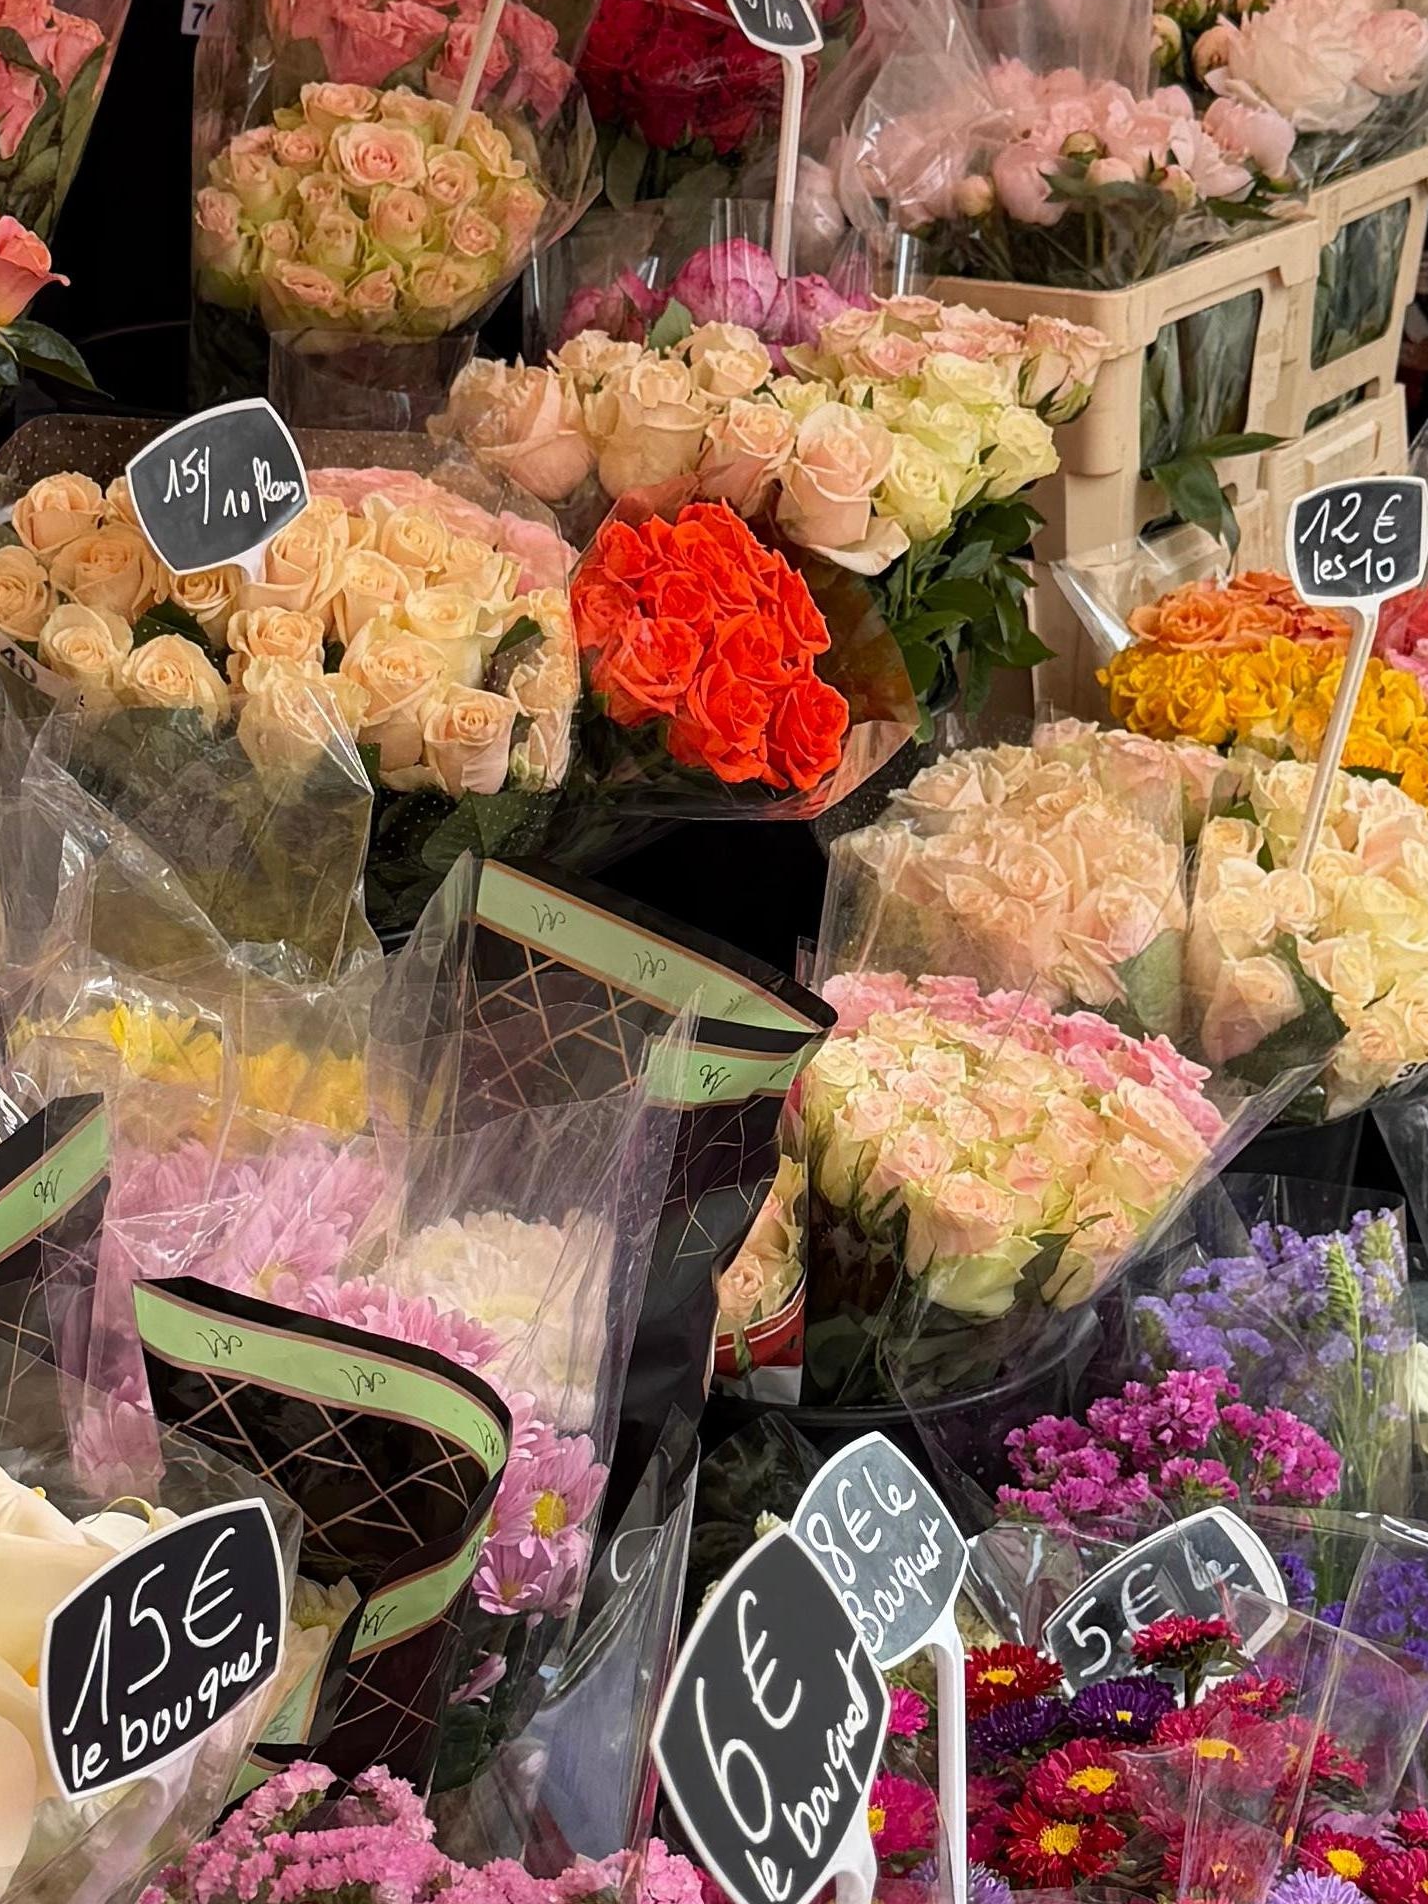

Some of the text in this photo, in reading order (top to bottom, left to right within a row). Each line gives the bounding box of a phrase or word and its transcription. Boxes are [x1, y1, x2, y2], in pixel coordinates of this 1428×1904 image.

[1313, 548, 1395, 586] les 10
[62, 1527, 243, 1737] 15€
[72, 1622, 273, 1789] le bouquet
[745, 1629, 870, 1903] le bouquet
